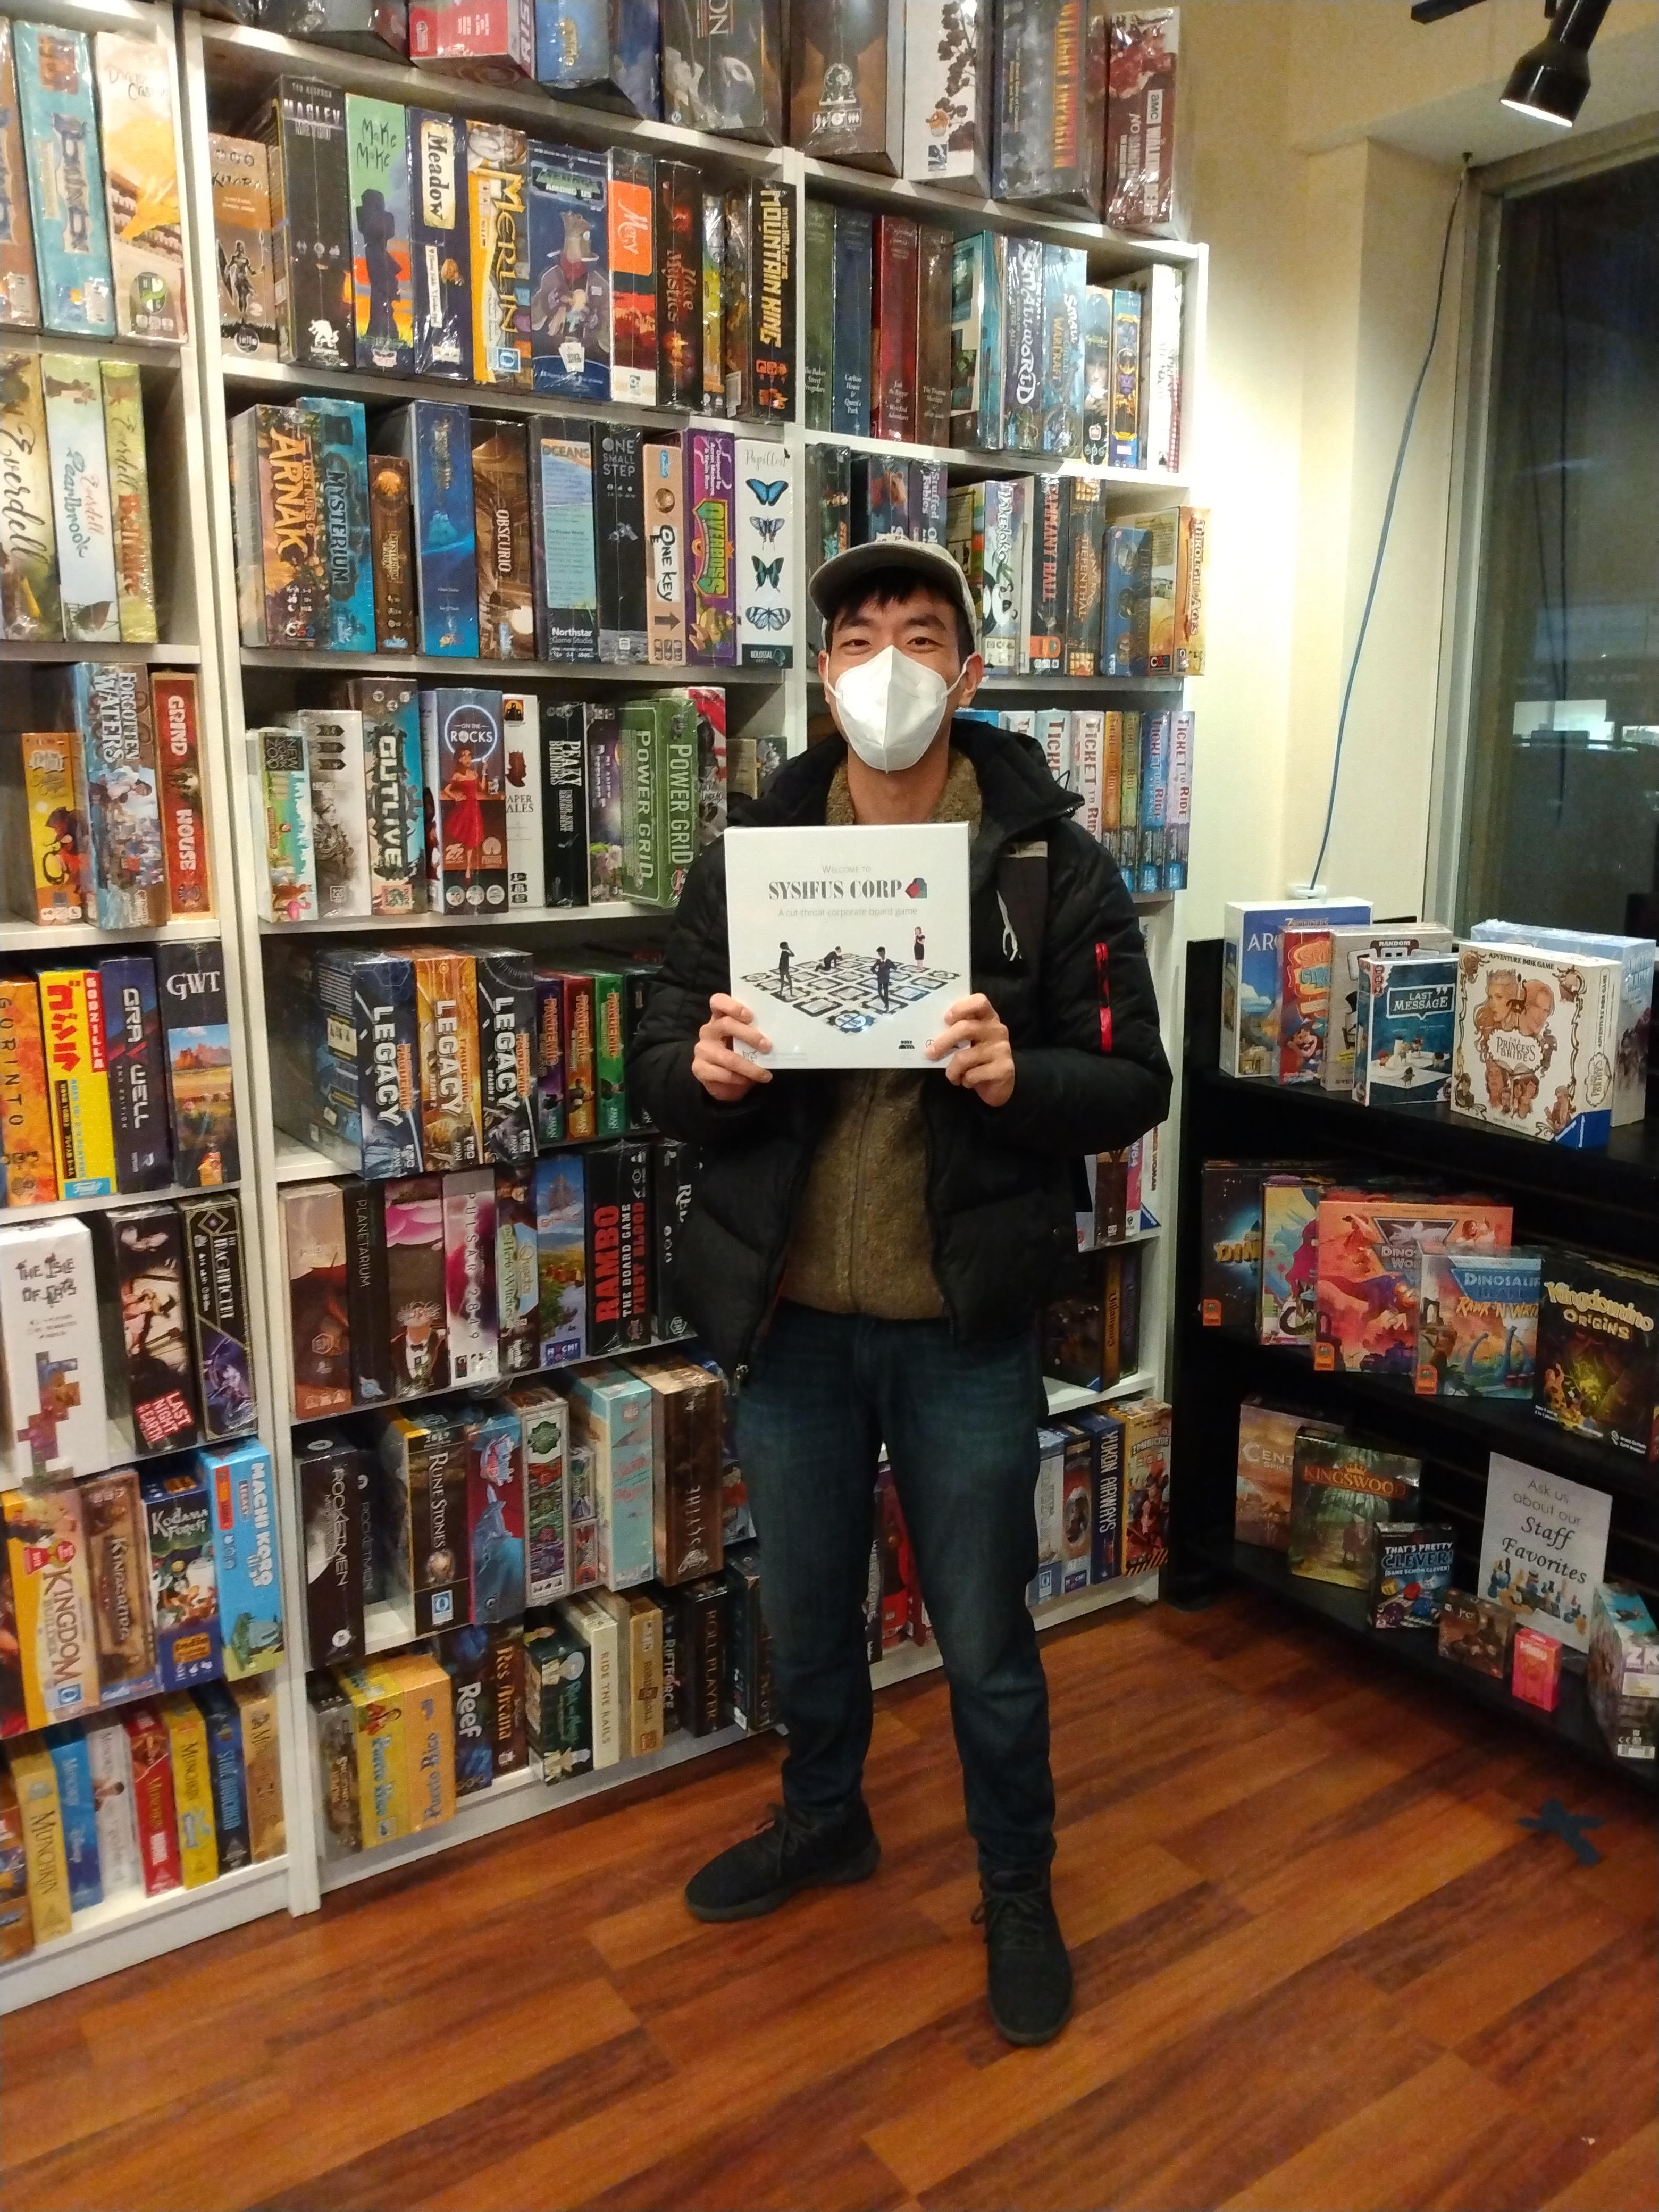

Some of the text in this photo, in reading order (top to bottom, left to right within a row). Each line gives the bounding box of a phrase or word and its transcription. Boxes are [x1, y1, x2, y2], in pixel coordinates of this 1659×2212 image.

[426, 132, 449, 220] Meadow
[760, 189, 782, 349] MOUNTAIN KING
[602, 437, 635, 455] ONE
[602, 453, 635, 465] SMALL
[269, 426, 309, 561] ARNAK
[603, 464, 636, 479] STEP
[921, 474, 931, 514] Fables
[929, 468, 940, 520] Stuffed
[326, 471, 350, 585] MYSTERIUM
[496, 509, 513, 573] OBSCURIO
[705, 506, 726, 595] OVERBOSS
[656, 569, 678, 603] KEY
[1042, 562, 1058, 602] HALL
[552, 627, 593, 638] Northstar
[93, 672, 124, 764] WATERS
[118, 672, 140, 760] FORGOTTEN
[168, 695, 187, 756] GRIND
[450, 731, 493, 743] ROCKS
[266, 738, 279, 770] ZOO
[564, 740, 582, 787] PEAKY
[1083, 718, 1102, 786] TICKET
[1175, 717, 1191, 768] TICKET
[379, 735, 403, 869] OUTLIVE
[506, 794, 532, 804] APER
[506, 803, 534, 814] ALES
[636, 730, 654, 879] POWER GRID
[668, 743, 694, 865] POWER GRID
[1177, 785, 1191, 819] RIDE
[176, 809, 197, 872] HOUSE
[769, 879, 902, 901] SYSIFUS CORP
[778, 906, 918, 919] A cut-throat corporate board game
[166, 971, 221, 1001] GWT
[1489, 952, 1555, 970] ADVENTURE BOOK GAME
[1392, 995, 1449, 1012] MESSAGE
[1409, 991, 1434, 1002] LAST
[373, 1005, 404, 1129] LEGACY
[435, 1000, 464, 1116] LEGACY
[492, 996, 521, 1112] LEGACY
[1496, 1036, 1536, 1062] PRINCESS
[1501, 1049, 1529, 1062] BRIDE
[355, 1199, 372, 1288] PLANETARIUM
[465, 1192, 478, 1272] PULSAR
[594, 1205, 620, 1323] RAMBO
[621, 1203, 632, 1318] THE BOARD GAME
[1544, 1281, 1654, 1333] Kingdomino
[1563, 1308, 1631, 1340] ORIGINS
[152, 1397, 180, 1435] NIGHT
[166, 1390, 194, 1426] LAST
[1132, 1436, 1170, 1455] ZOMBICIDE
[250, 1462, 270, 1528] MACHI
[429, 1451, 449, 1549] RUNE STONES
[1099, 1430, 1118, 1535] YUKON AIRWAYS
[1303, 1466, 1408, 1496] KINGSWOOD
[1528, 1479, 1570, 1505] Ask us
[331, 1467, 350, 1587] ROCKETMEN
[1513, 1492, 1582, 1526] about our
[1521, 1516, 1575, 1551] Staff
[1382, 1549, 1454, 1569] CLEVER!
[1385, 1542, 1453, 1554] THAT'S PRETTY
[1502, 1536, 1587, 1585] Favorites
[44, 1566, 83, 1686] KINGDOM
[496, 1646, 514, 1680] Res
[663, 1638, 677, 1710] RIFTFORCE
[457, 1681, 482, 1738] Reef
[600, 1652, 610, 1745] RIDE THE RAILS
[30, 1809, 58, 1896] MUNCHKIN
